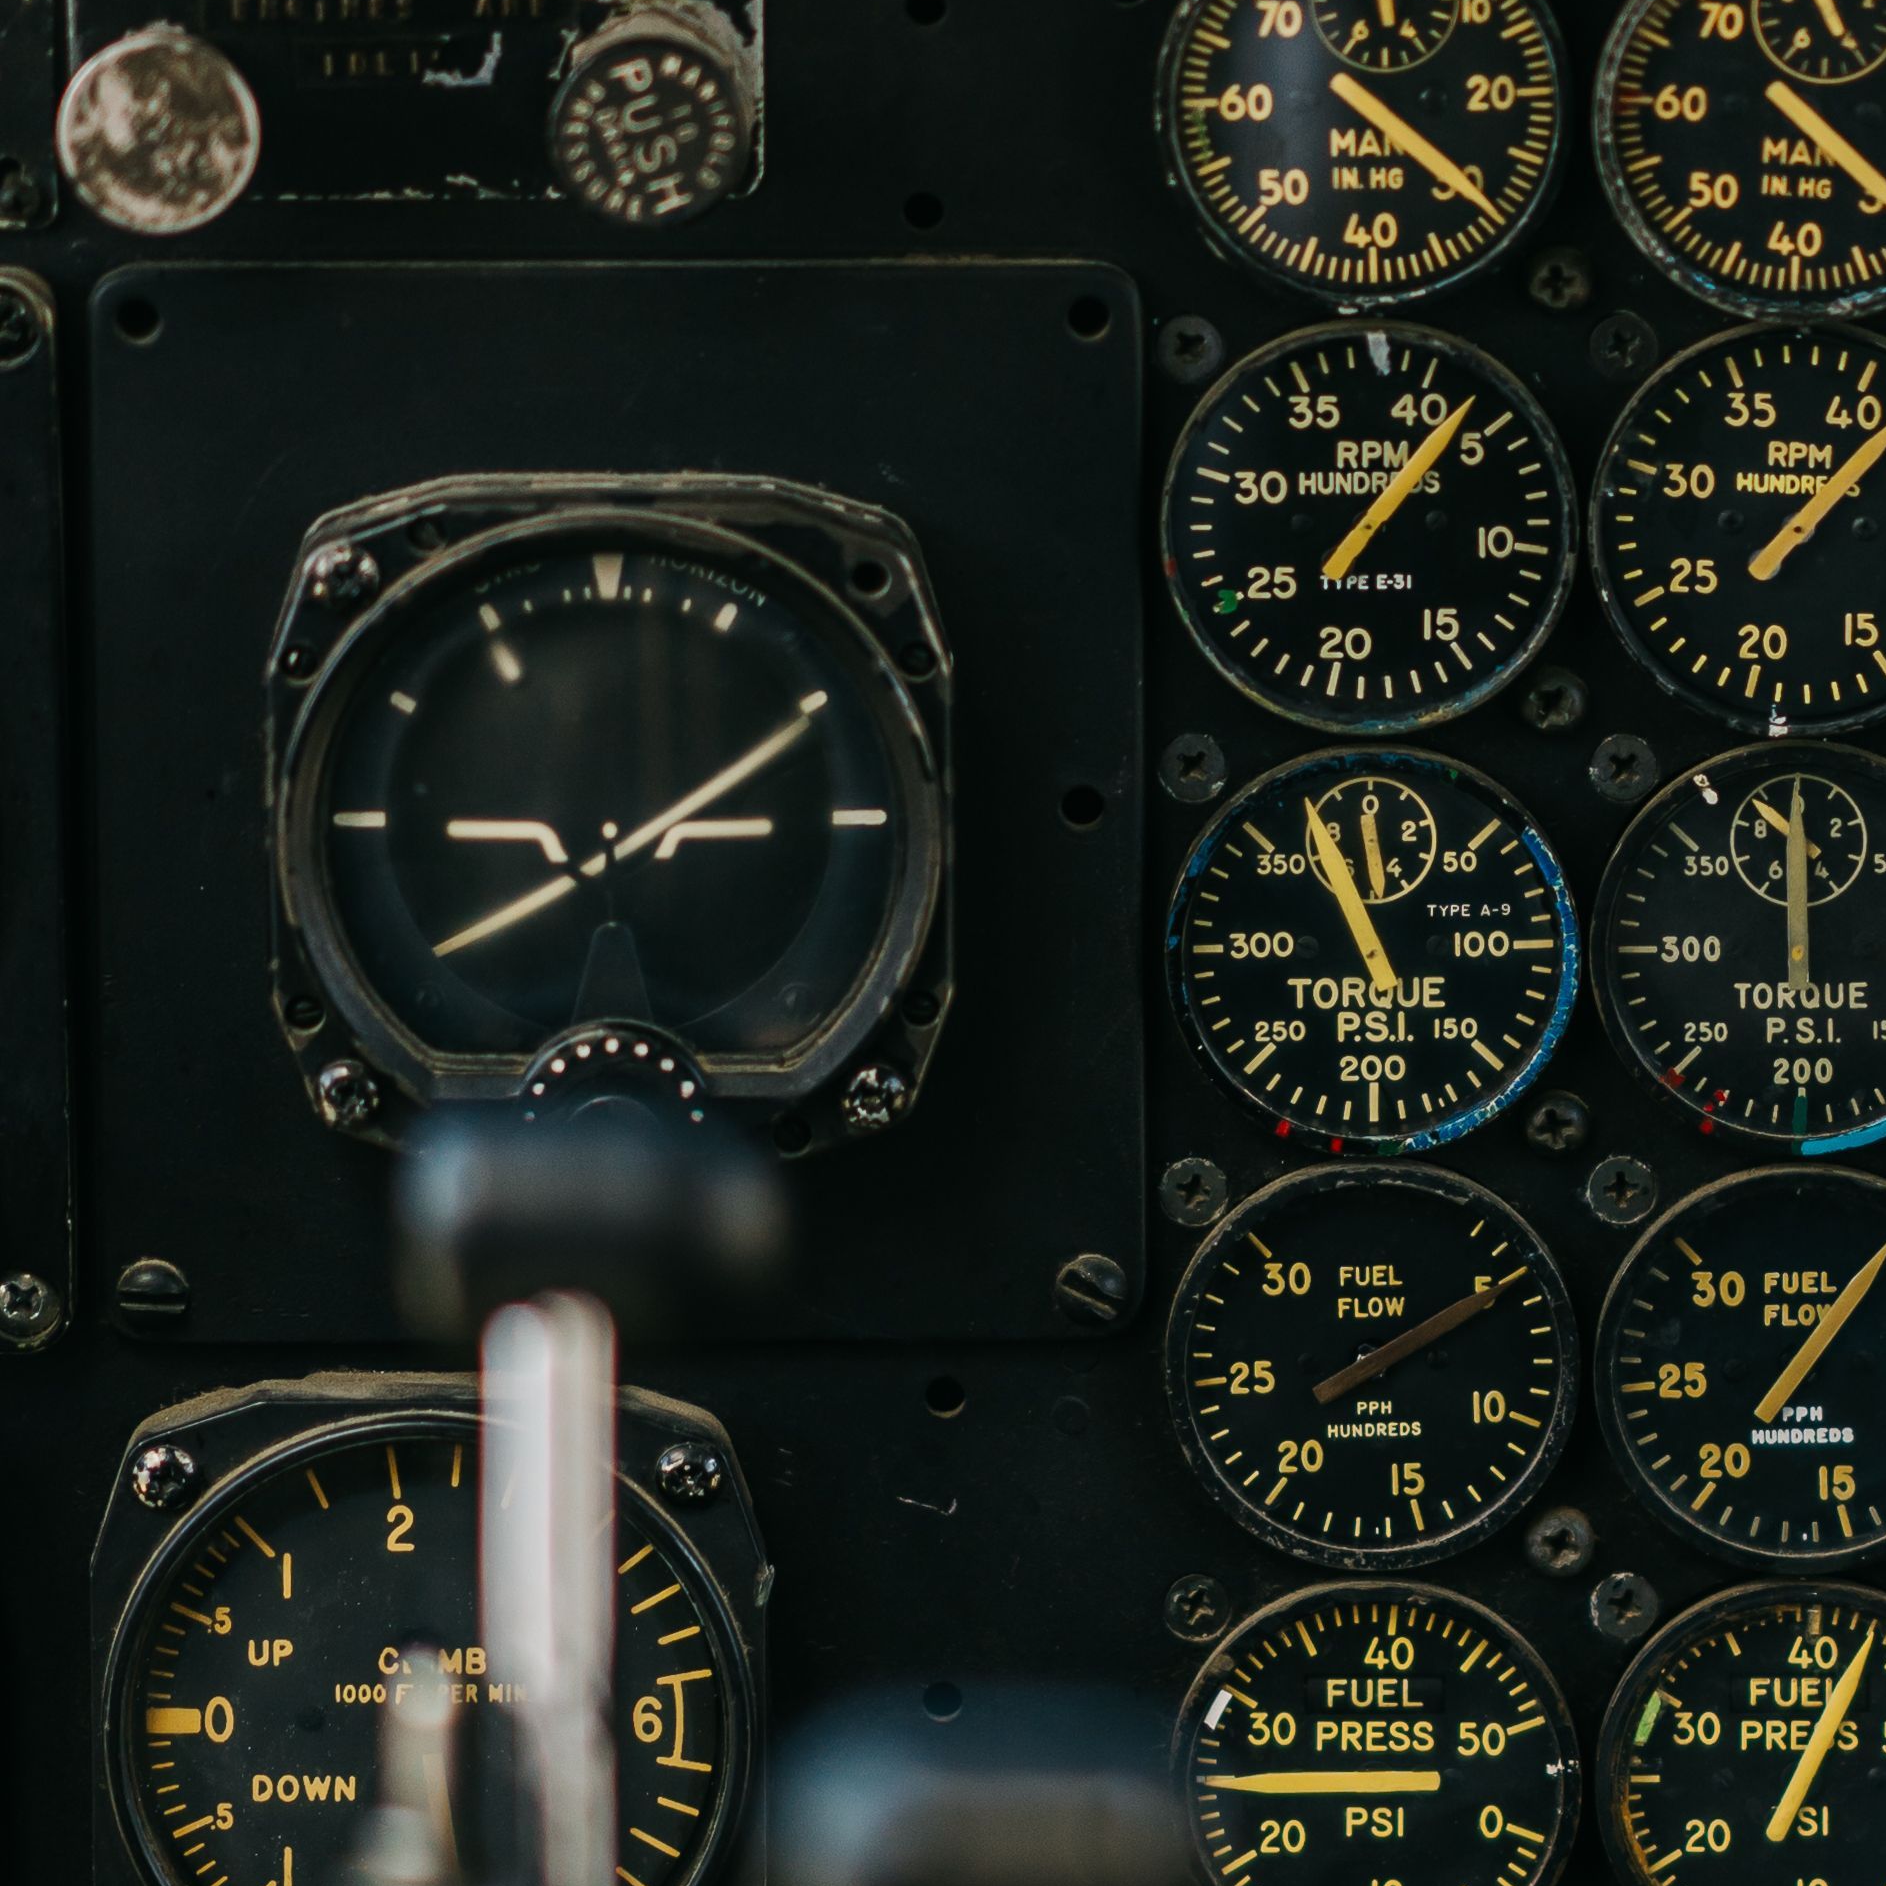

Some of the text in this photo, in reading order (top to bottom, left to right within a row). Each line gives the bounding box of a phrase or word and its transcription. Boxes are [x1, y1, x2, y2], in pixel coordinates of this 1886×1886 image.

[1219, 84, 1273, 121] 60
[1654, 84, 1707, 121] 60
[608, 58, 693, 215] PUSH
[1333, 168, 1404, 190] IN. HG
[1798, 178, 1832, 199] HG
[1344, 212, 1398, 249] 40
[1767, 221, 1822, 257] 40
[1337, 441, 1410, 468] RPM
[1768, 442, 1832, 470] RPM
[1234, 471, 1287, 505] 30
[1320, 574, 1412, 590] TYPE E-31
[1738, 624, 1787, 659] 20
[1427, 904, 1511, 917] TYPE A-9
[1229, 932, 1294, 959] 300
[1288, 978, 1445, 1010] TORQUE
[1734, 982, 1868, 1009] TORQUE
[1773, 1058, 1833, 1085] 200
[1262, 1262, 1311, 1297] 30
[1340, 1266, 1402, 1286] FUEL
[1691, 1271, 1745, 1308] 30
[1764, 1272, 1837, 1294] FUEL
[1338, 1297, 1405, 1318] FLOW
[1357, 1401, 1392, 1415] PPH
[1782, 1407, 1823, 1421] PPH
[1327, 1423, 1421, 1438] HUNDREDS
[1752, 1428, 1854, 1445] HUNDREDS
[1700, 1444, 1751, 1479] 20
[249, 1640, 294, 1667] UP
[1788, 1636, 1838, 1669] 40
[335, 1683, 387, 1703] 1000
[1326, 1679, 1423, 1708] FUEL
[632, 1697, 663, 1743] 6
[1248, 1713, 1296, 1746] 30
[1317, 1721, 1433, 1752] PRESS
[252, 1775, 357, 1803] DOWN
[1346, 1808, 1404, 1838] PSI
